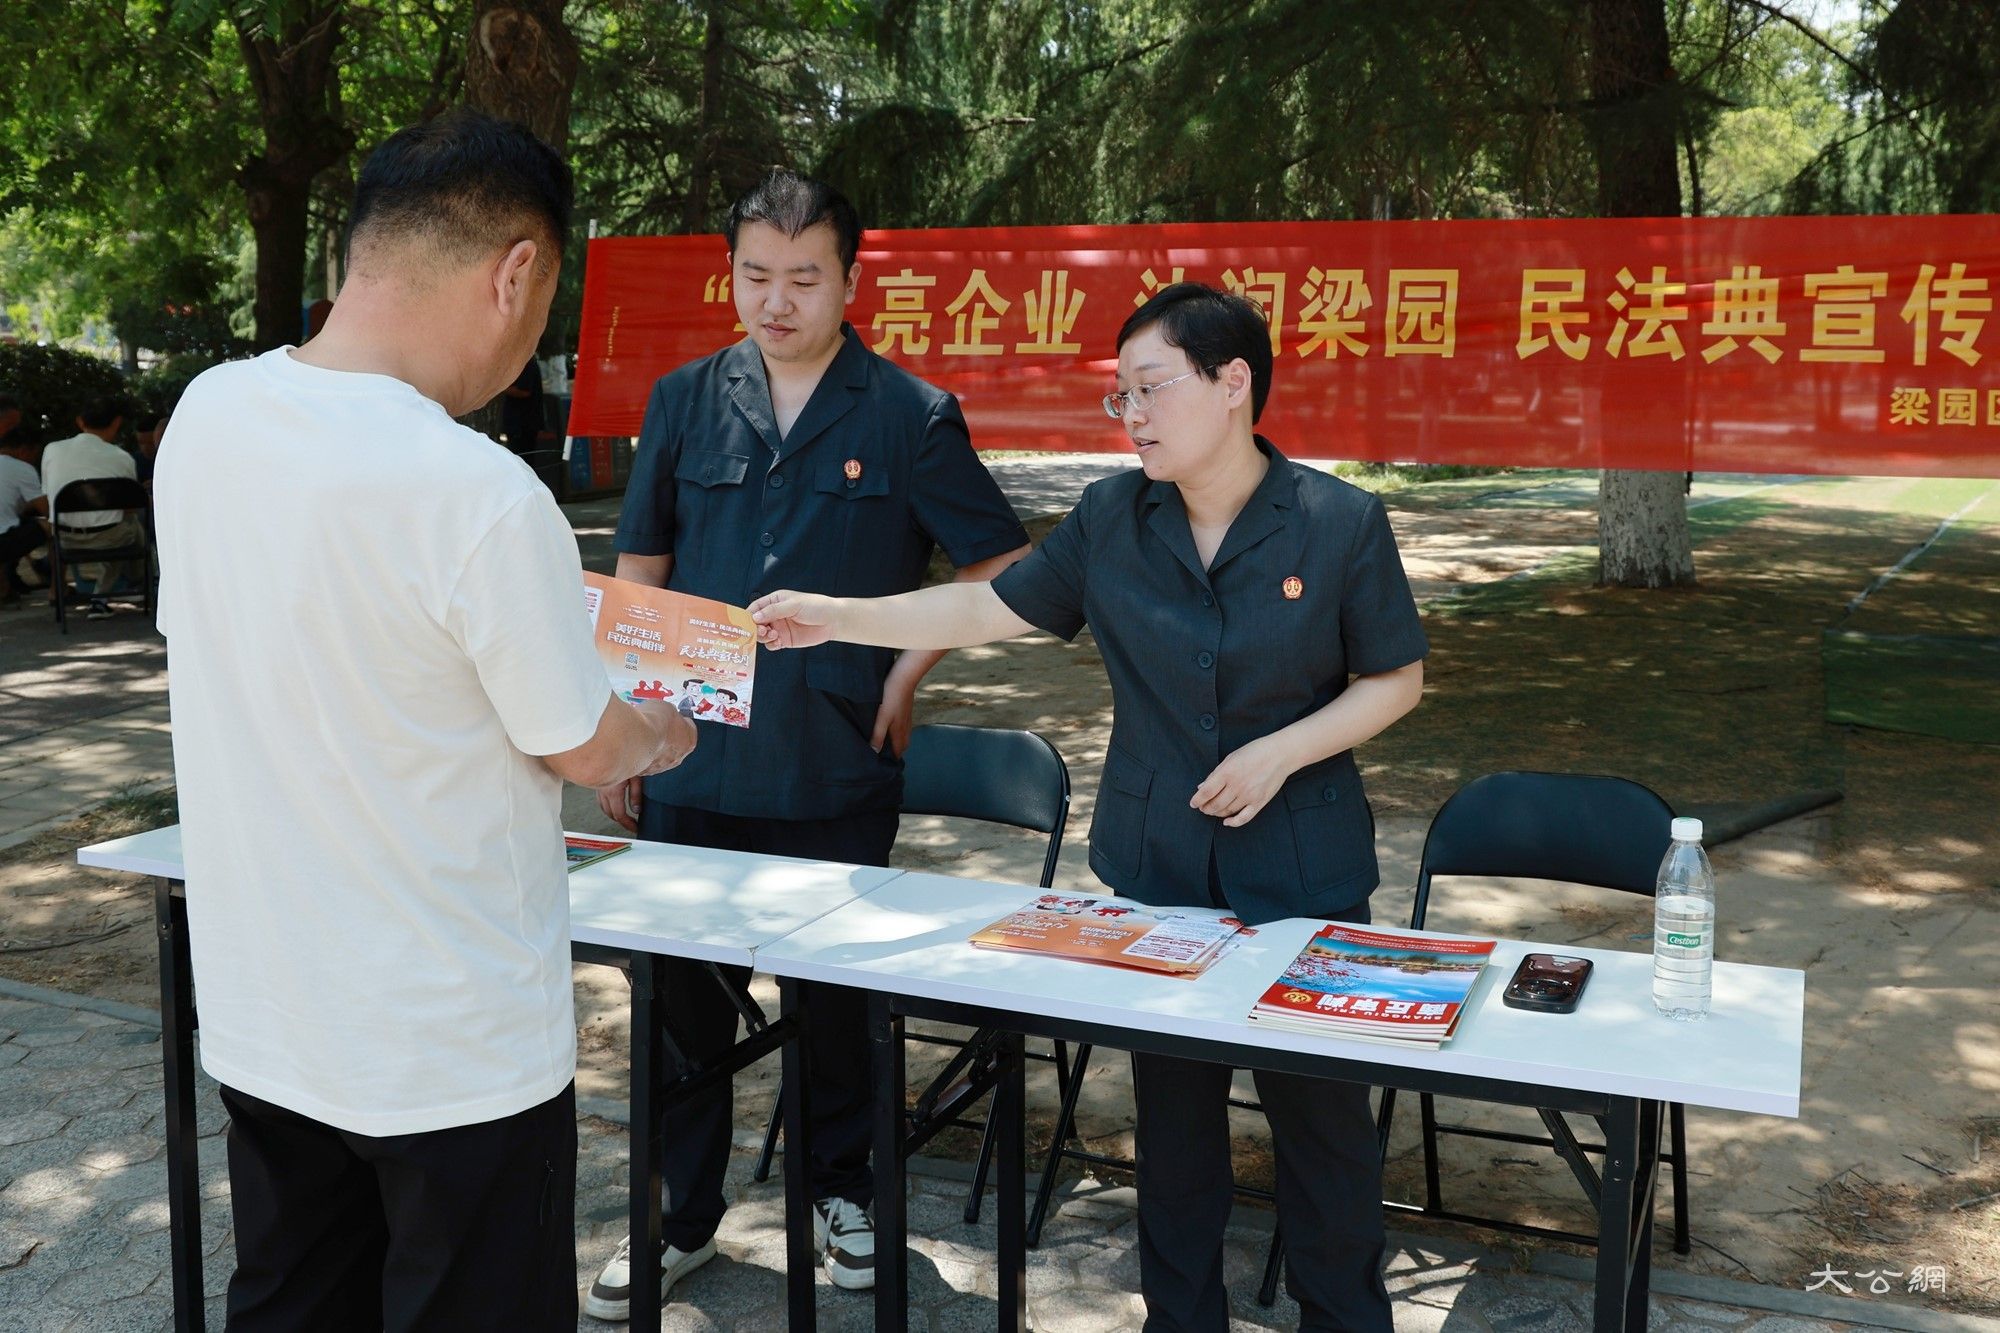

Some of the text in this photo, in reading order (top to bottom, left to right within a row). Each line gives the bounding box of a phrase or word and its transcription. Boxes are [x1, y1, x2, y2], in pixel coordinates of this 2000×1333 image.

[1515, 263, 1993, 367] 民法典宣传
